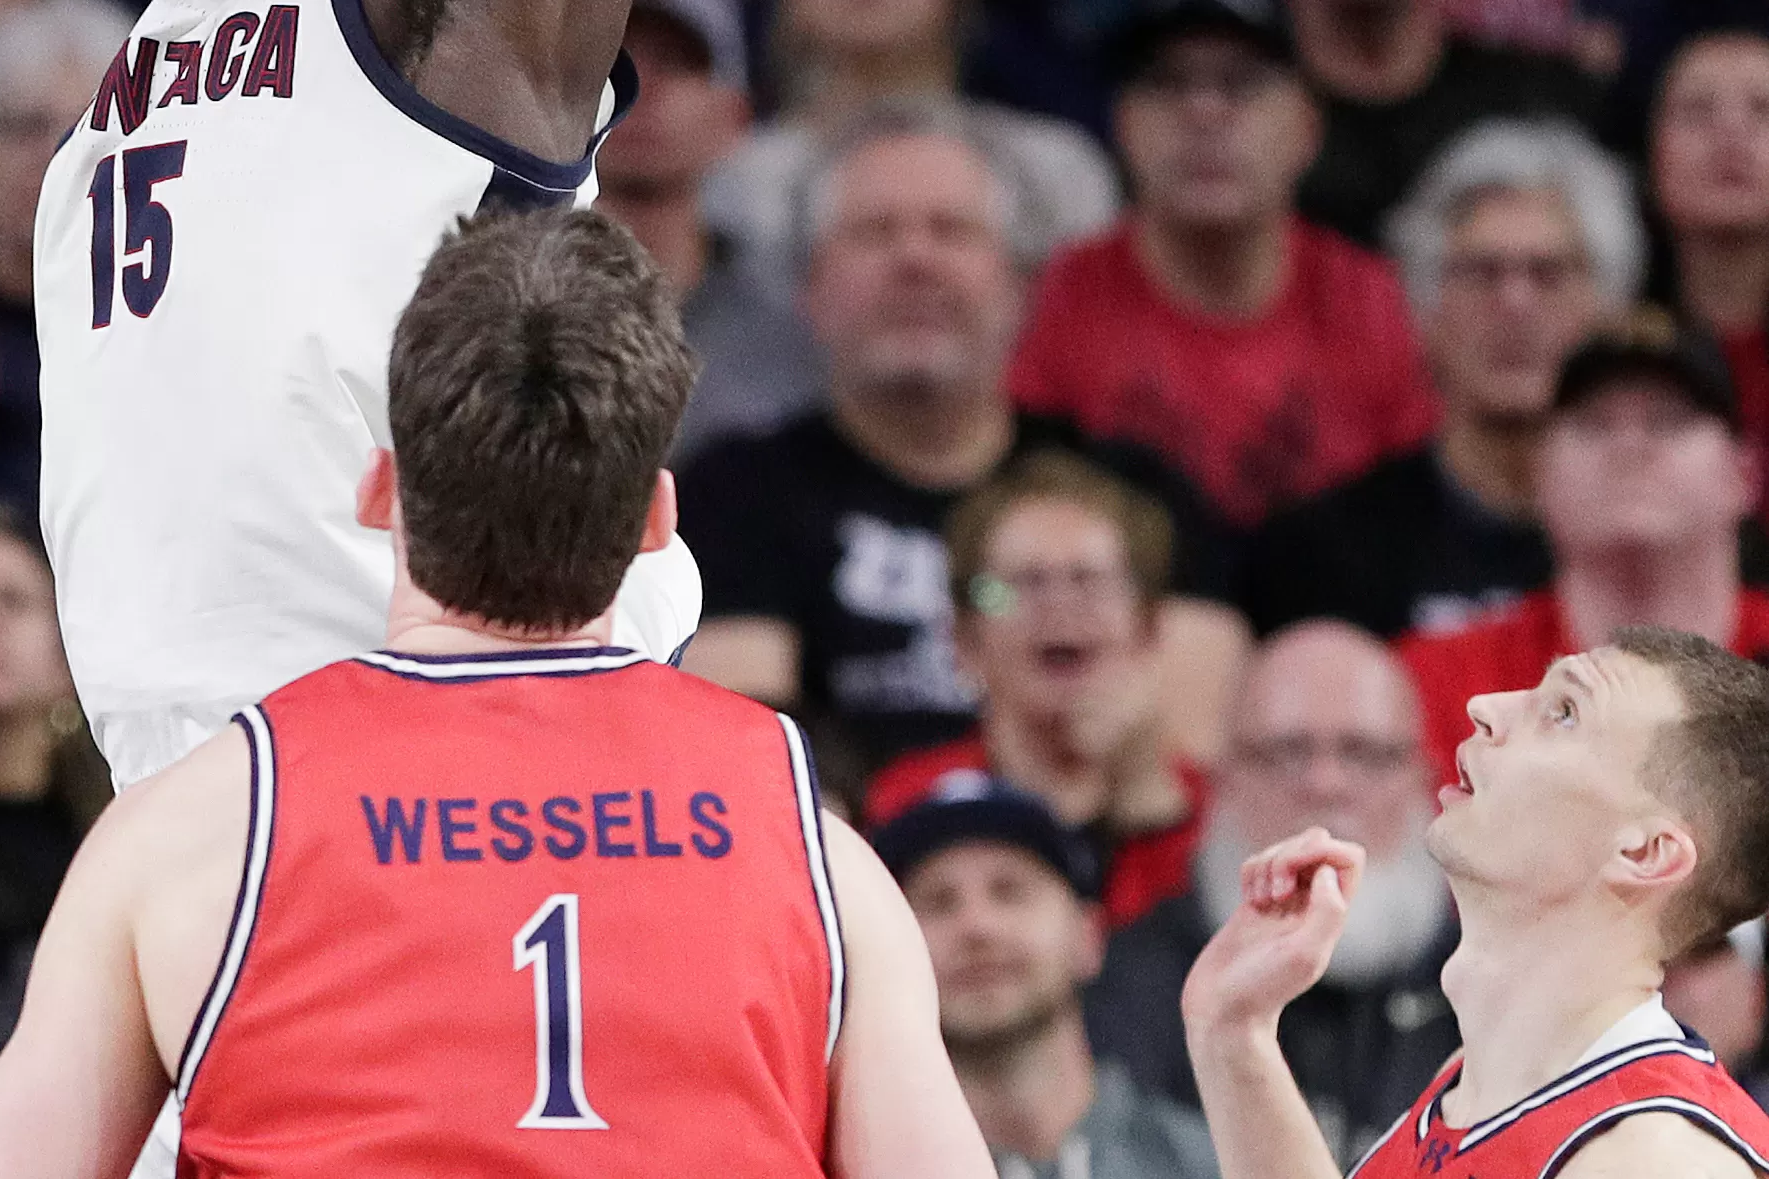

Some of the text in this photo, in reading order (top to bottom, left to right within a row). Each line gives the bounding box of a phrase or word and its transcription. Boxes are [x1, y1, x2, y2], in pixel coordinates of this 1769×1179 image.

[87, 139, 188, 330] 15
[360, 789, 734, 865] WESSELS
[511, 892, 611, 1131] 1
